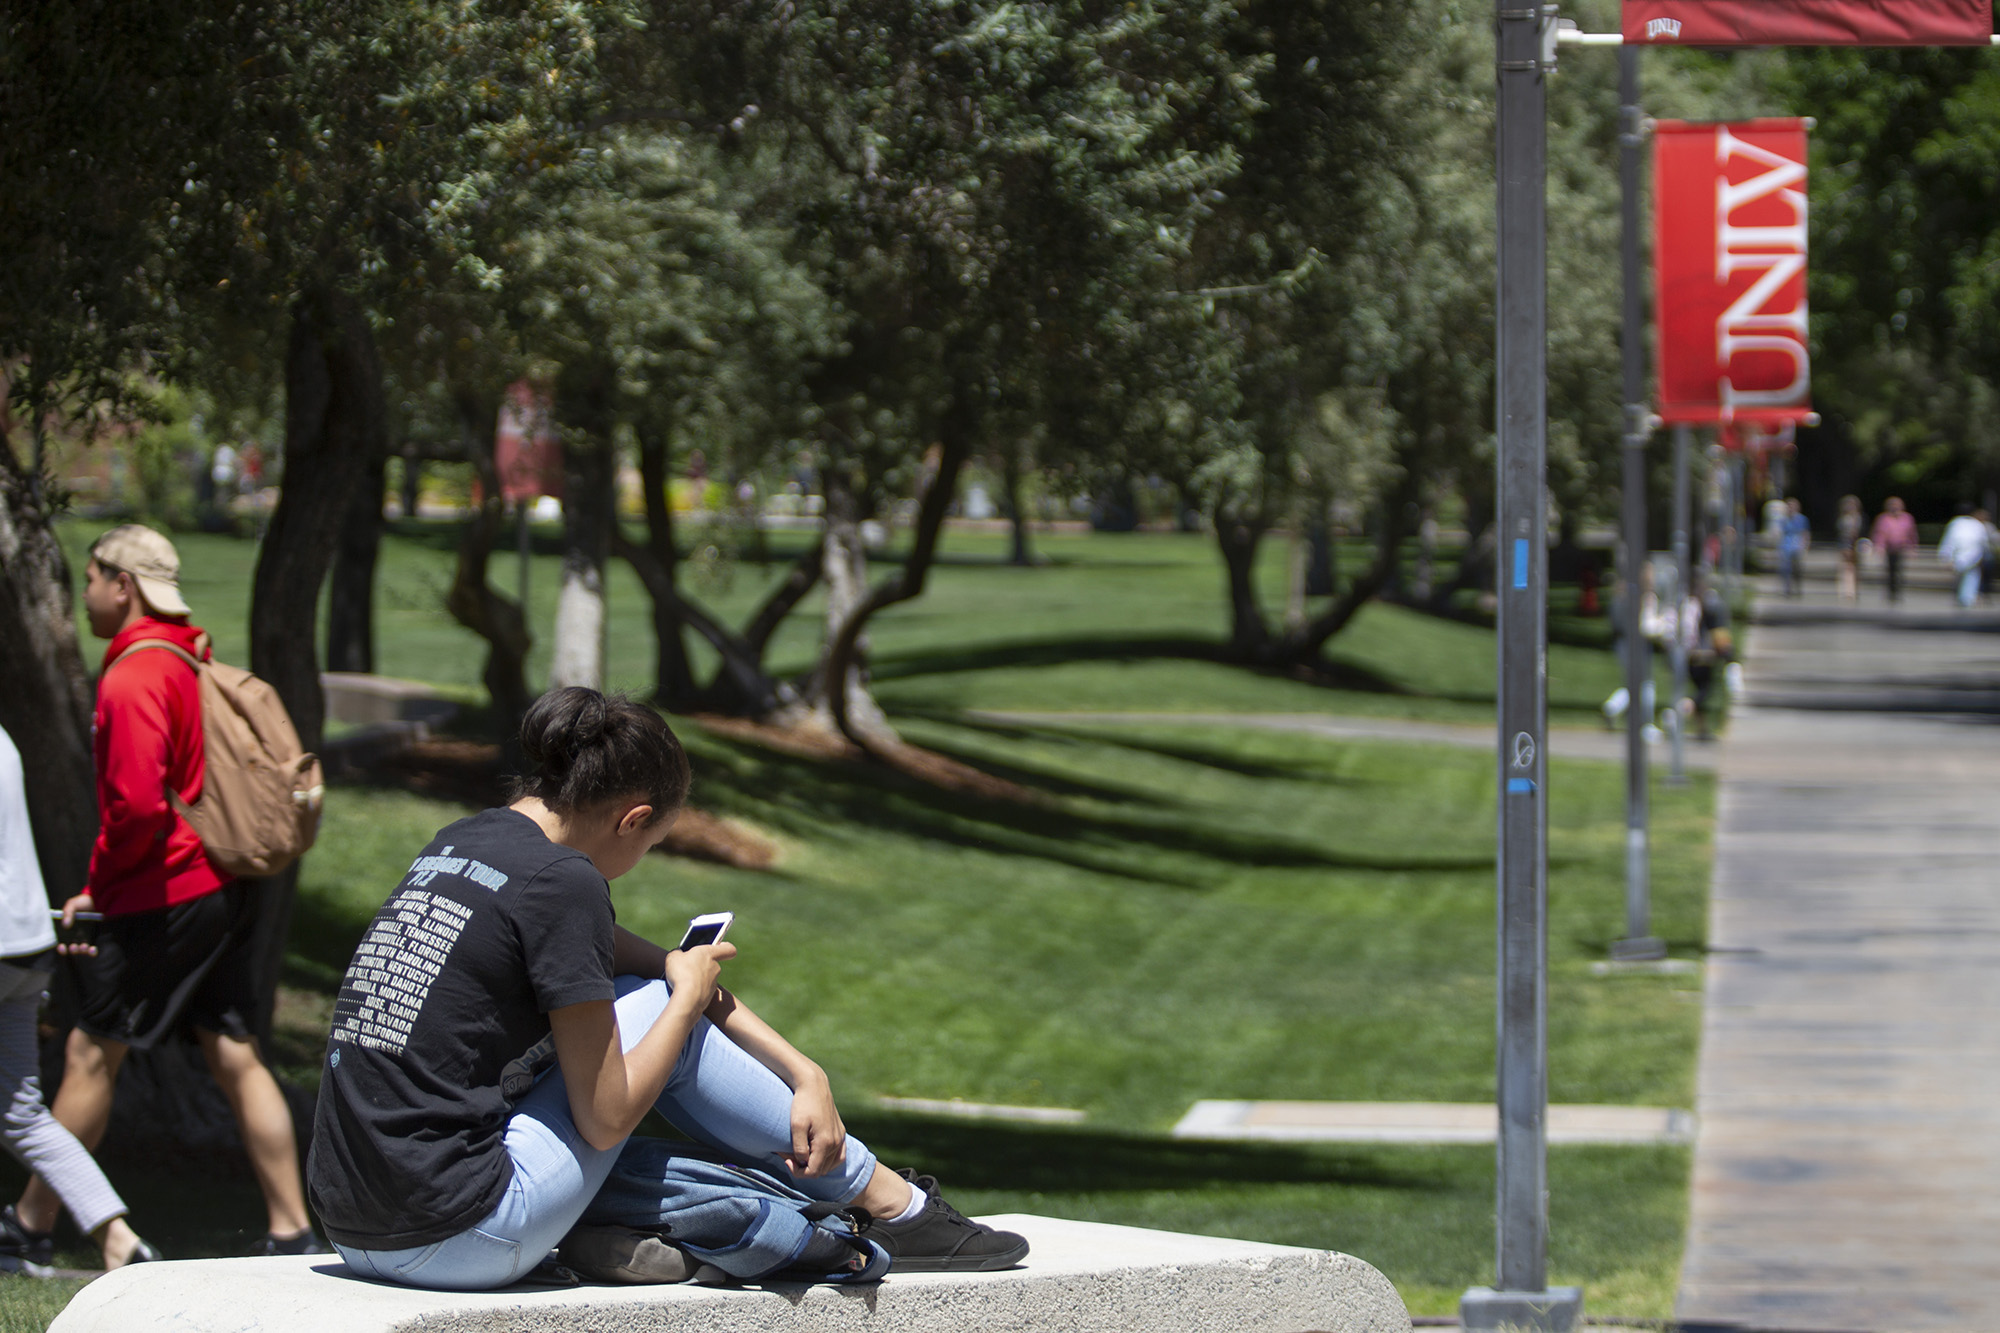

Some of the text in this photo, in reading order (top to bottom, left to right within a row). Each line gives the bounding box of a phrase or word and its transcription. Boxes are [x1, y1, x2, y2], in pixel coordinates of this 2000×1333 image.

[1645, 17, 1682, 39] UNLV
[1714, 123, 1810, 424] UNLV
[463, 860, 508, 892] TOUR
[429, 908, 466, 932] INDIANA
[430, 894, 474, 920] MICHIGAN
[404, 924, 454, 954] TENNESSEE
[421, 917, 460, 943] ILLINOIS
[395, 949, 442, 977] CAROLINA
[407, 939, 447, 966] FLORIDA
[387, 960, 436, 987] KENTUCKY
[378, 985, 424, 1011] MONTANA
[390, 975, 429, 999] DAKOTA
[358, 1006, 413, 1034] RENO, NEVADA
[364, 995, 419, 1023] BOISE, IDAHO
[358, 1033, 404, 1057] TENNESSEE
[361, 1021, 408, 1047] CALIFORNIA
